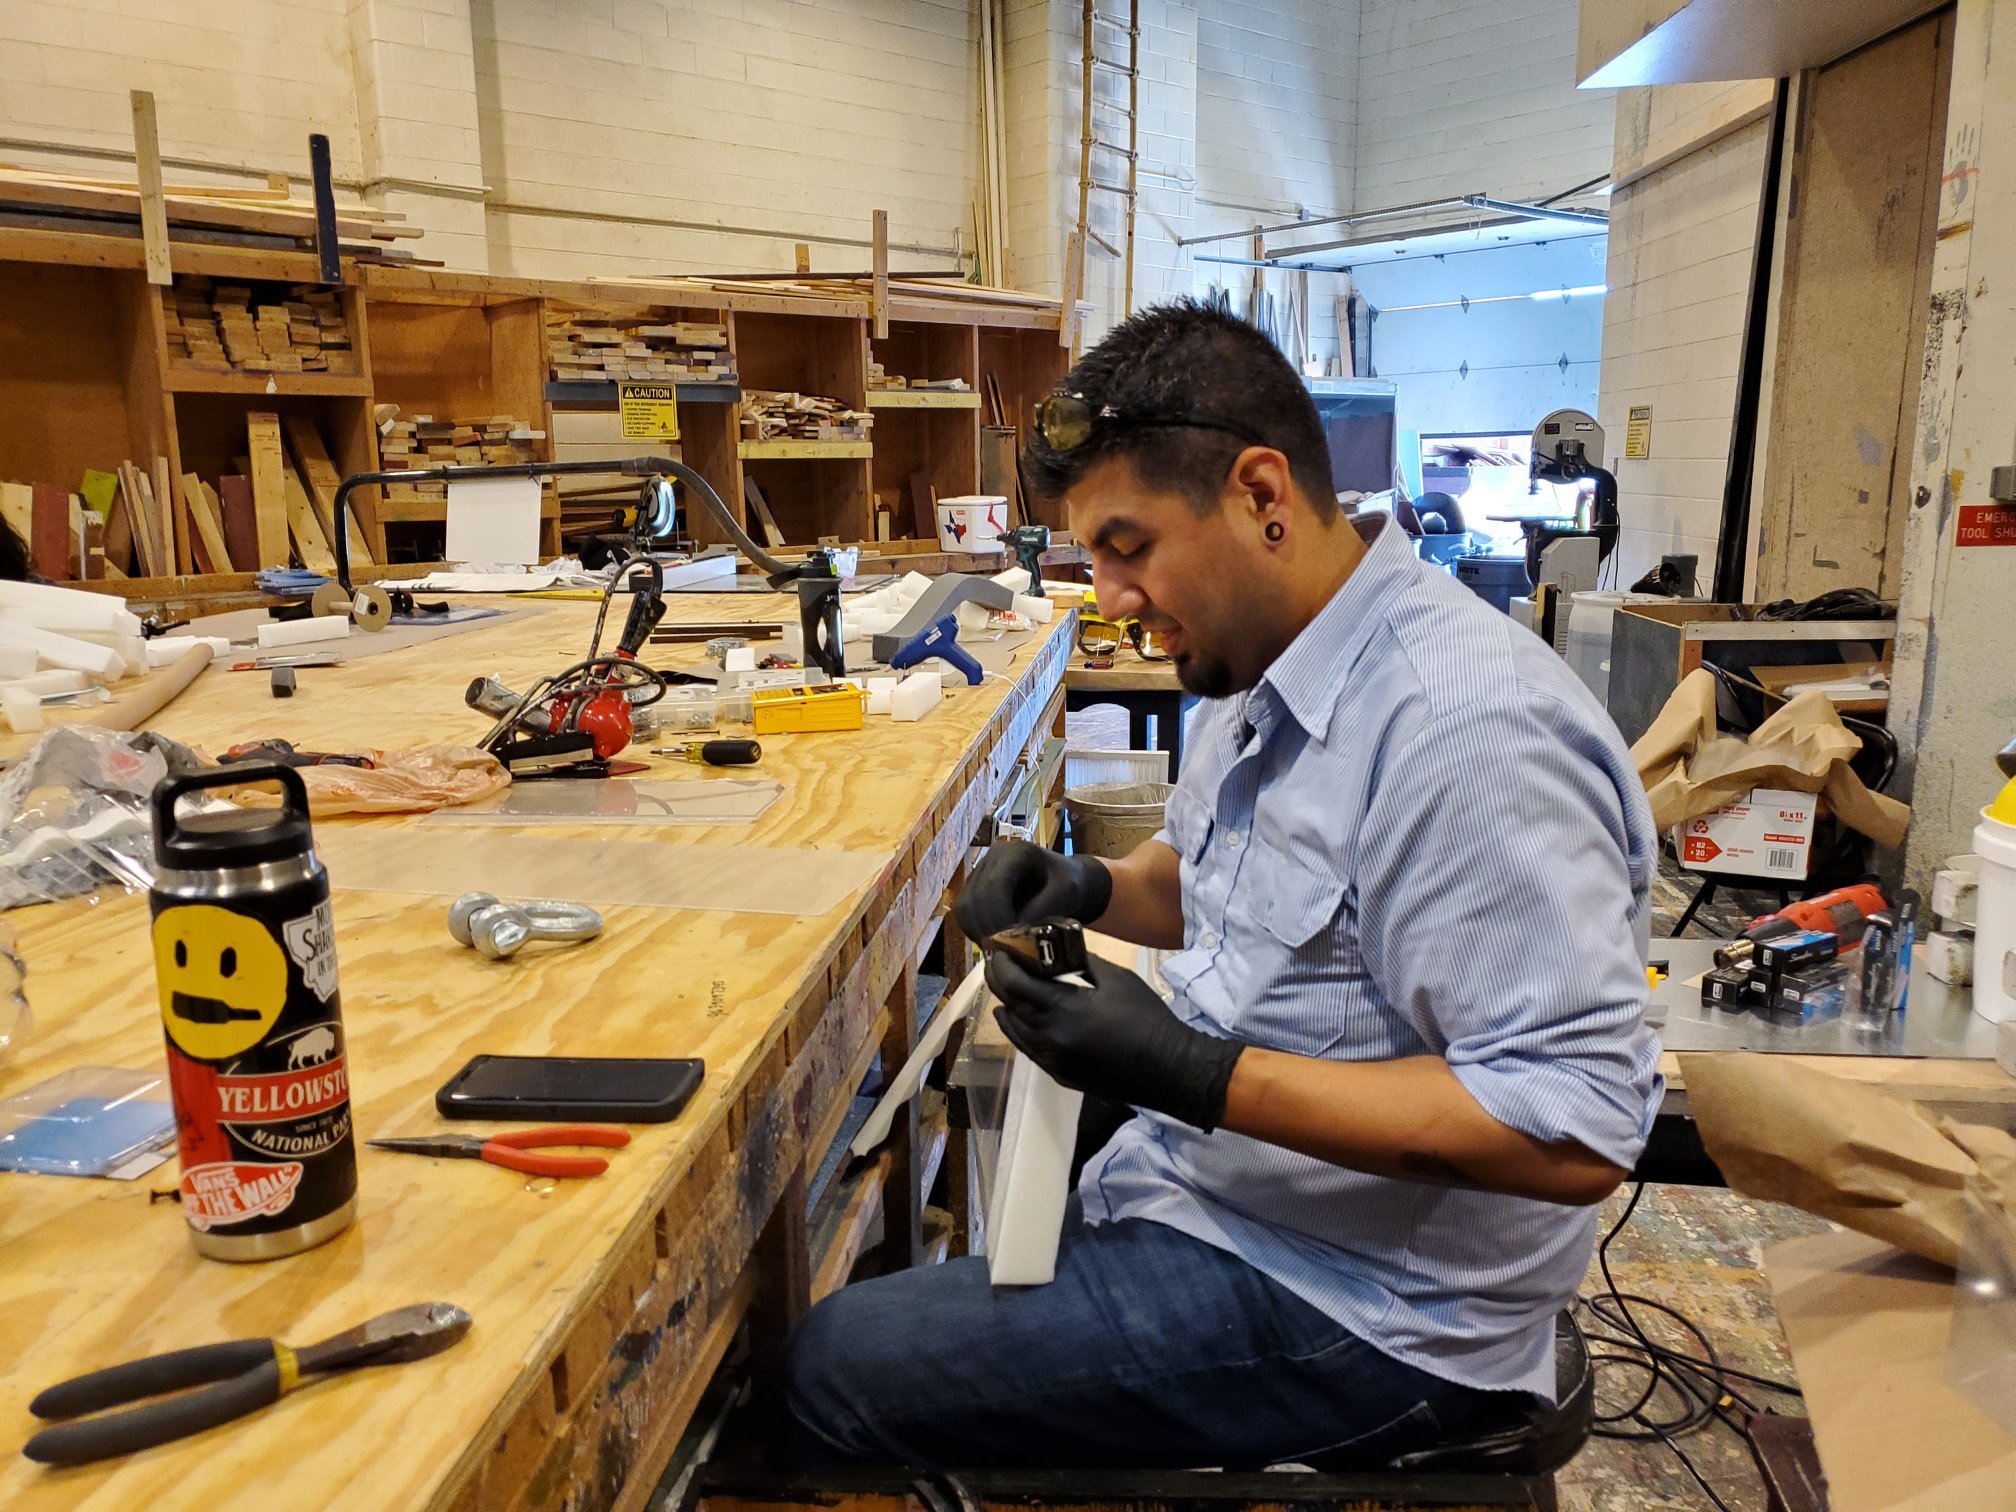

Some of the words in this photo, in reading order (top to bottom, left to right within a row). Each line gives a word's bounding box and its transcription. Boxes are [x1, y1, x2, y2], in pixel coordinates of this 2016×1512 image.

[634, 387, 670, 398] CAUTION
[1960, 527, 1988, 539] TOOL
[1695, 849, 1705, 857] 20
[251, 1128, 330, 1152] NATIONAL
[190, 1166, 240, 1194] VANS
[199, 1187, 242, 1217] THE
